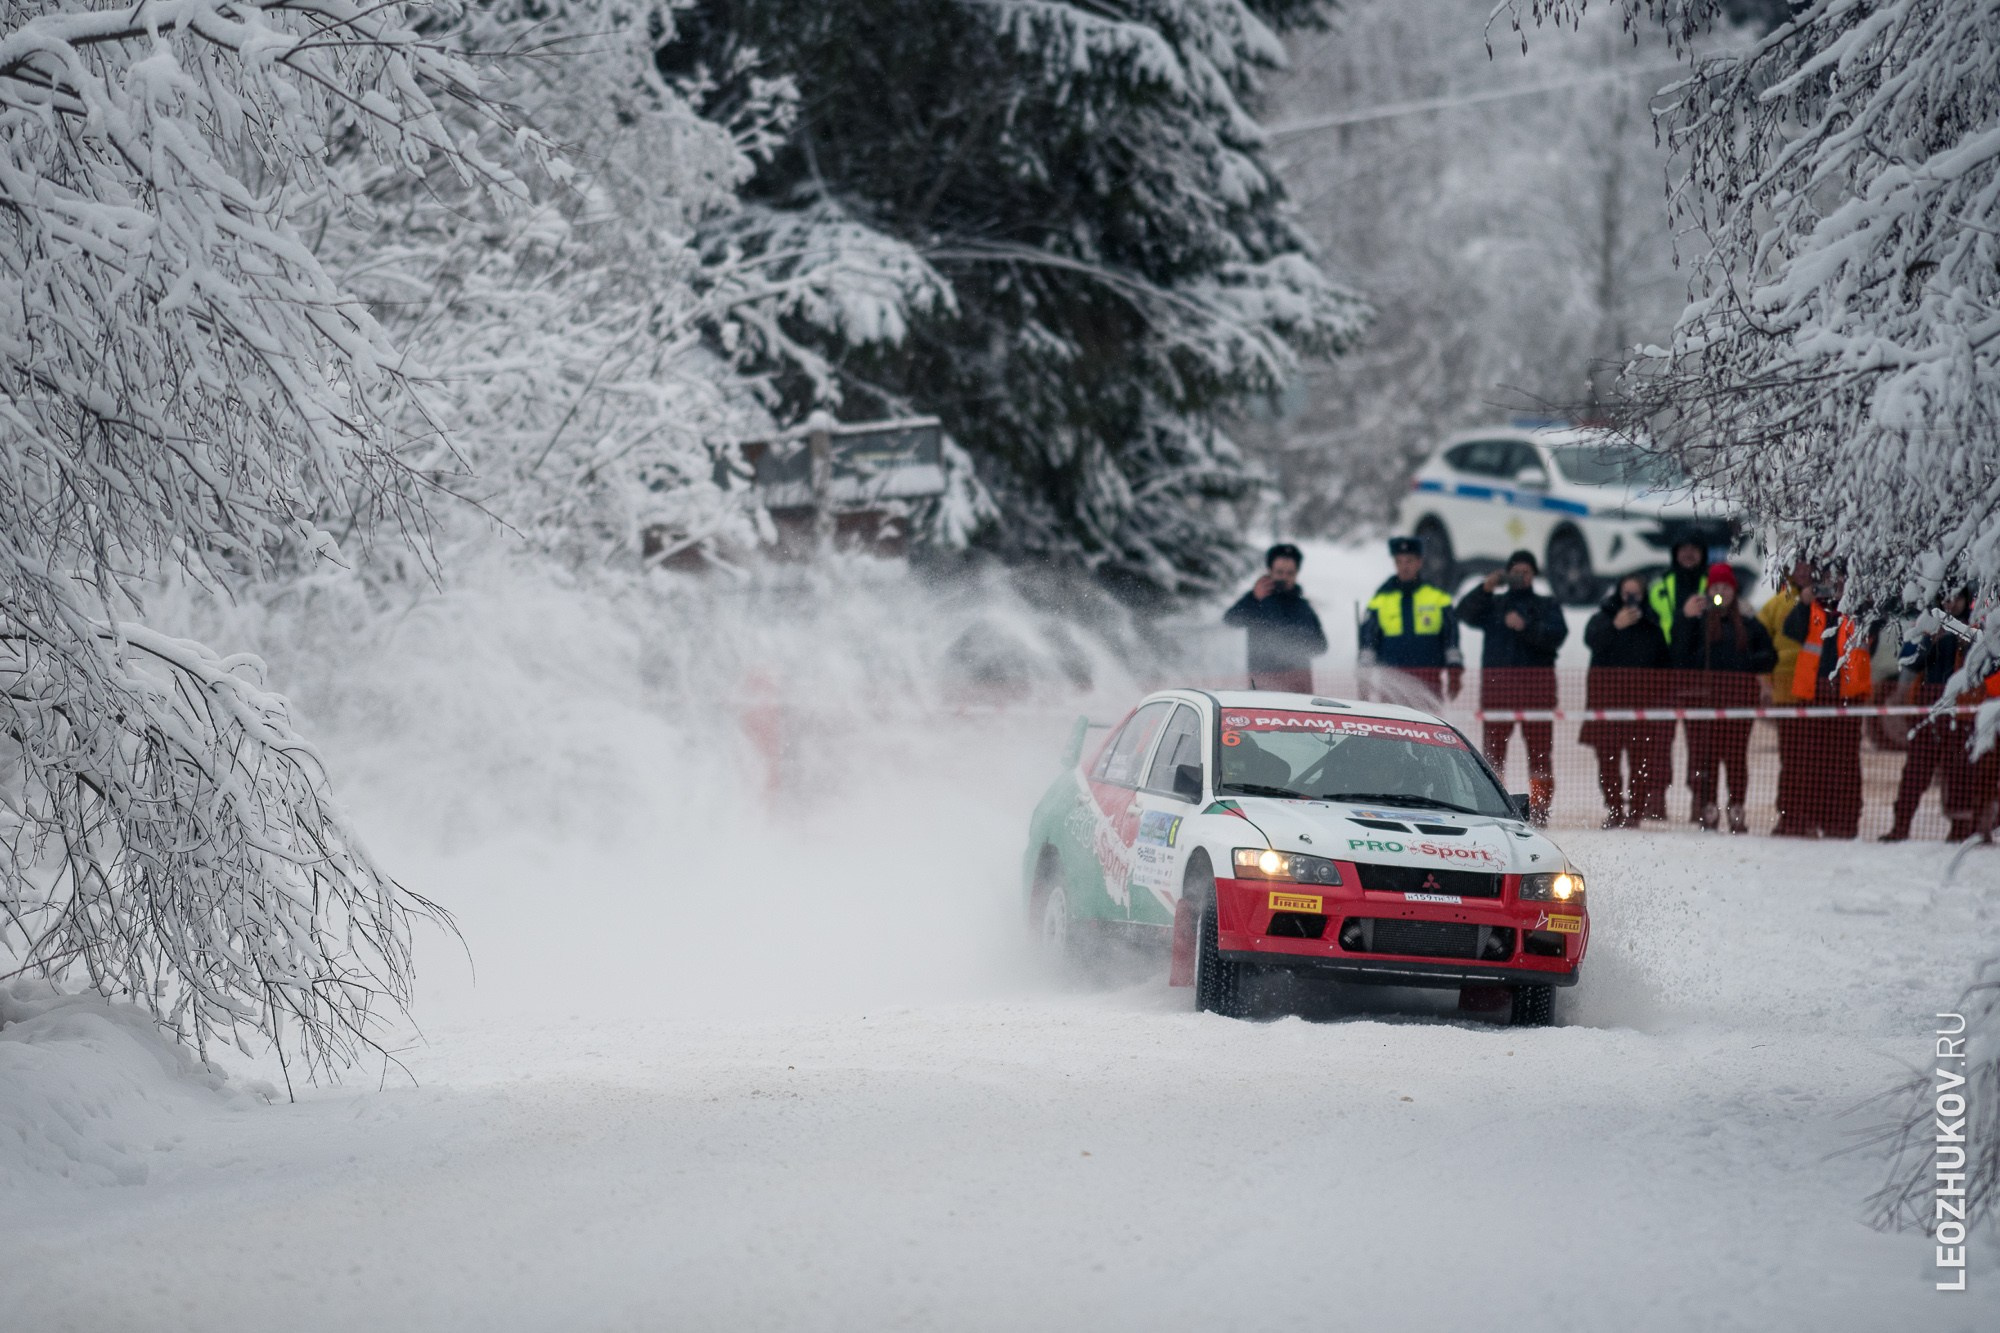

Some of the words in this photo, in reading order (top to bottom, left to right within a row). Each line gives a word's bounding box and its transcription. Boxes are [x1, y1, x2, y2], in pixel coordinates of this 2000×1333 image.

[1255, 717, 1334, 728] РАЛЛИ
[1341, 721, 1430, 739] РОССИИ
[1221, 731, 1241, 747] 6
[1273, 895, 1318, 909] PIRELLI
[1550, 917, 1580, 930] PIRELLI
